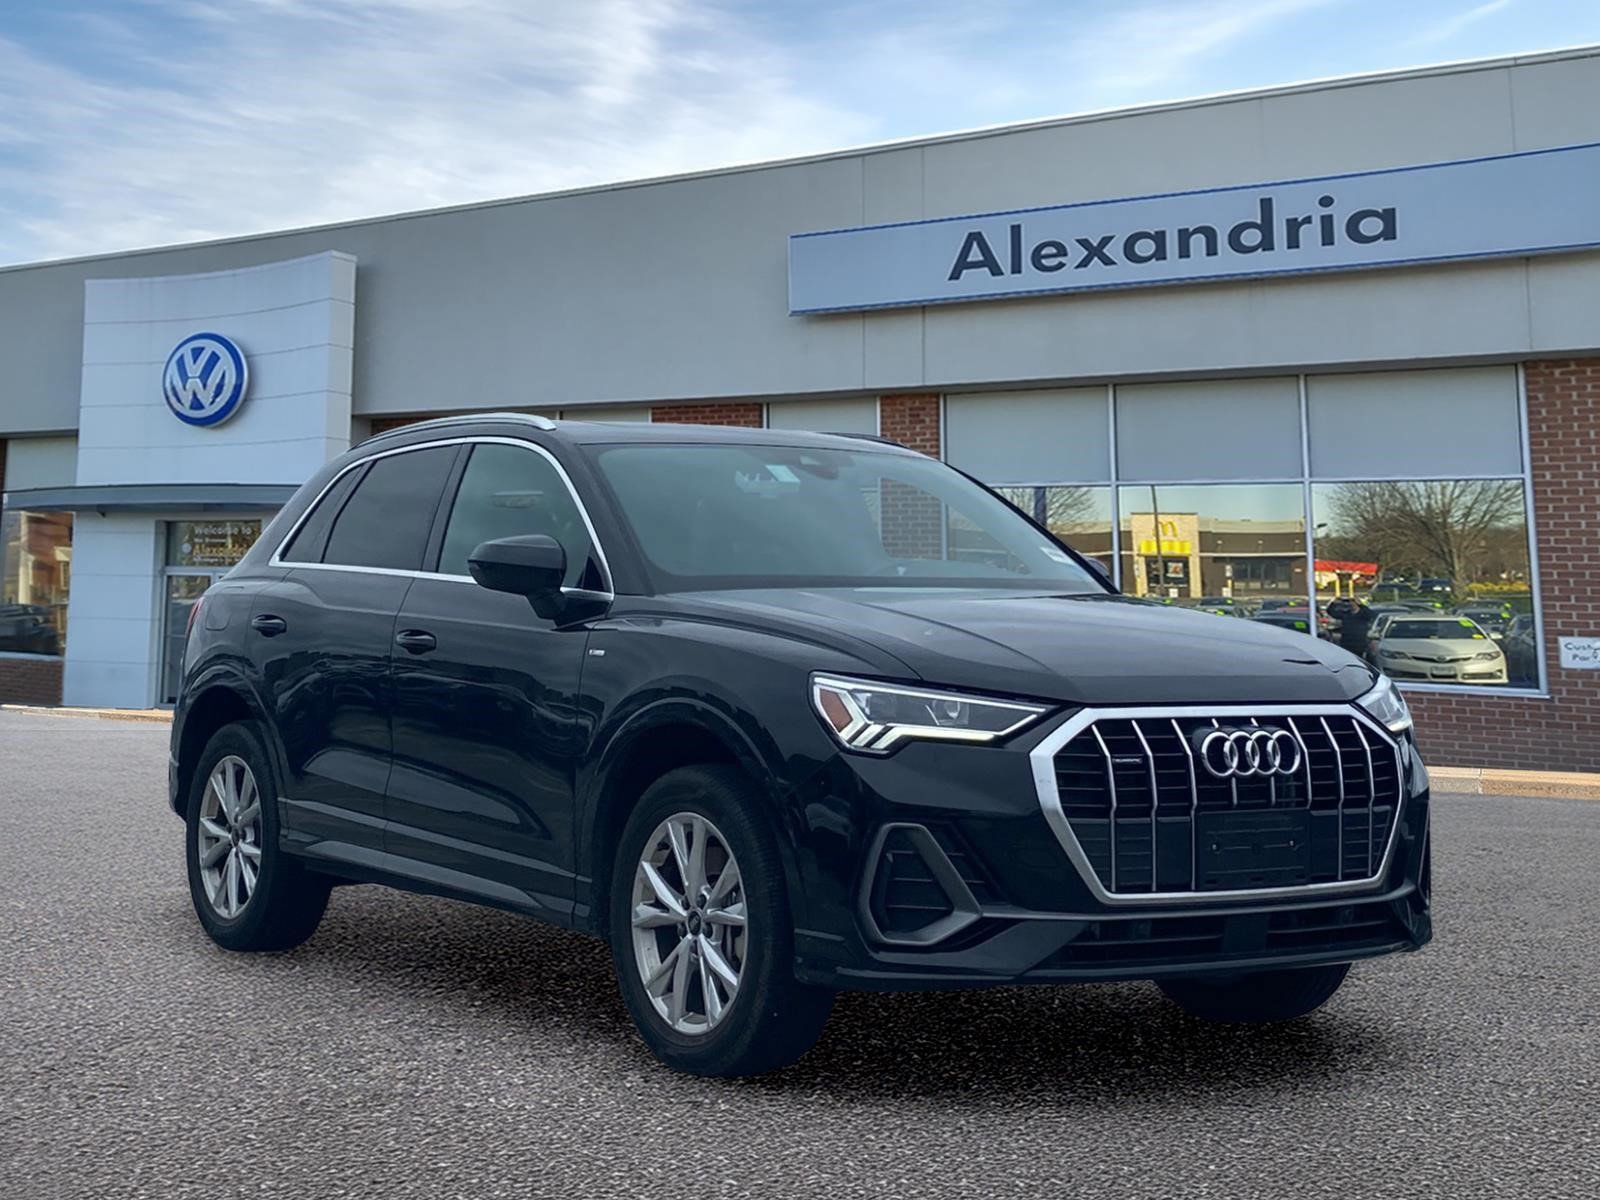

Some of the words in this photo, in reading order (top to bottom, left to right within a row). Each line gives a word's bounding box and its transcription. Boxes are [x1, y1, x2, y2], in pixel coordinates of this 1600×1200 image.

[947, 195, 1398, 281] Alexandria
[194, 525, 239, 535] Welcome
[241, 525, 252, 535] to
